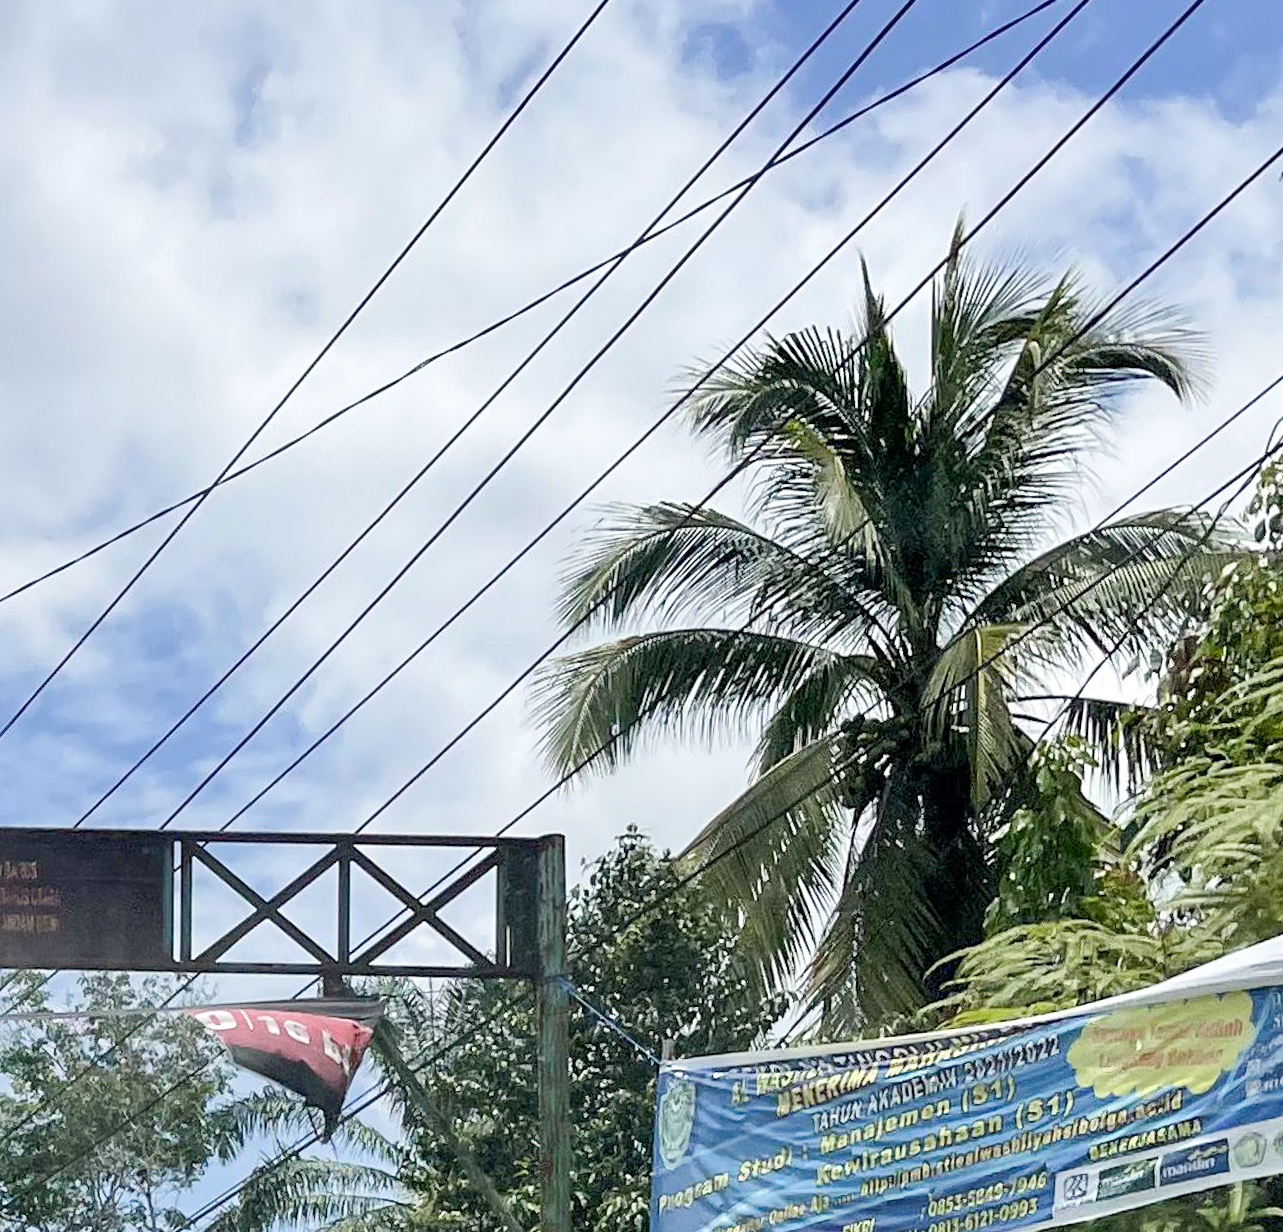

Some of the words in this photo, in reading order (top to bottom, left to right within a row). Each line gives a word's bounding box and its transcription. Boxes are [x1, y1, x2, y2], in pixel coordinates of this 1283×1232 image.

[812, 1100, 863, 1132] TAHUN
[820, 1098, 951, 1154] Manajemen
[962, 1073, 1016, 1113] (S1)
[1015, 1090, 1075, 1130] (S1)
[658, 1172, 730, 1215] Program
[737, 1147, 793, 1183] Studi
